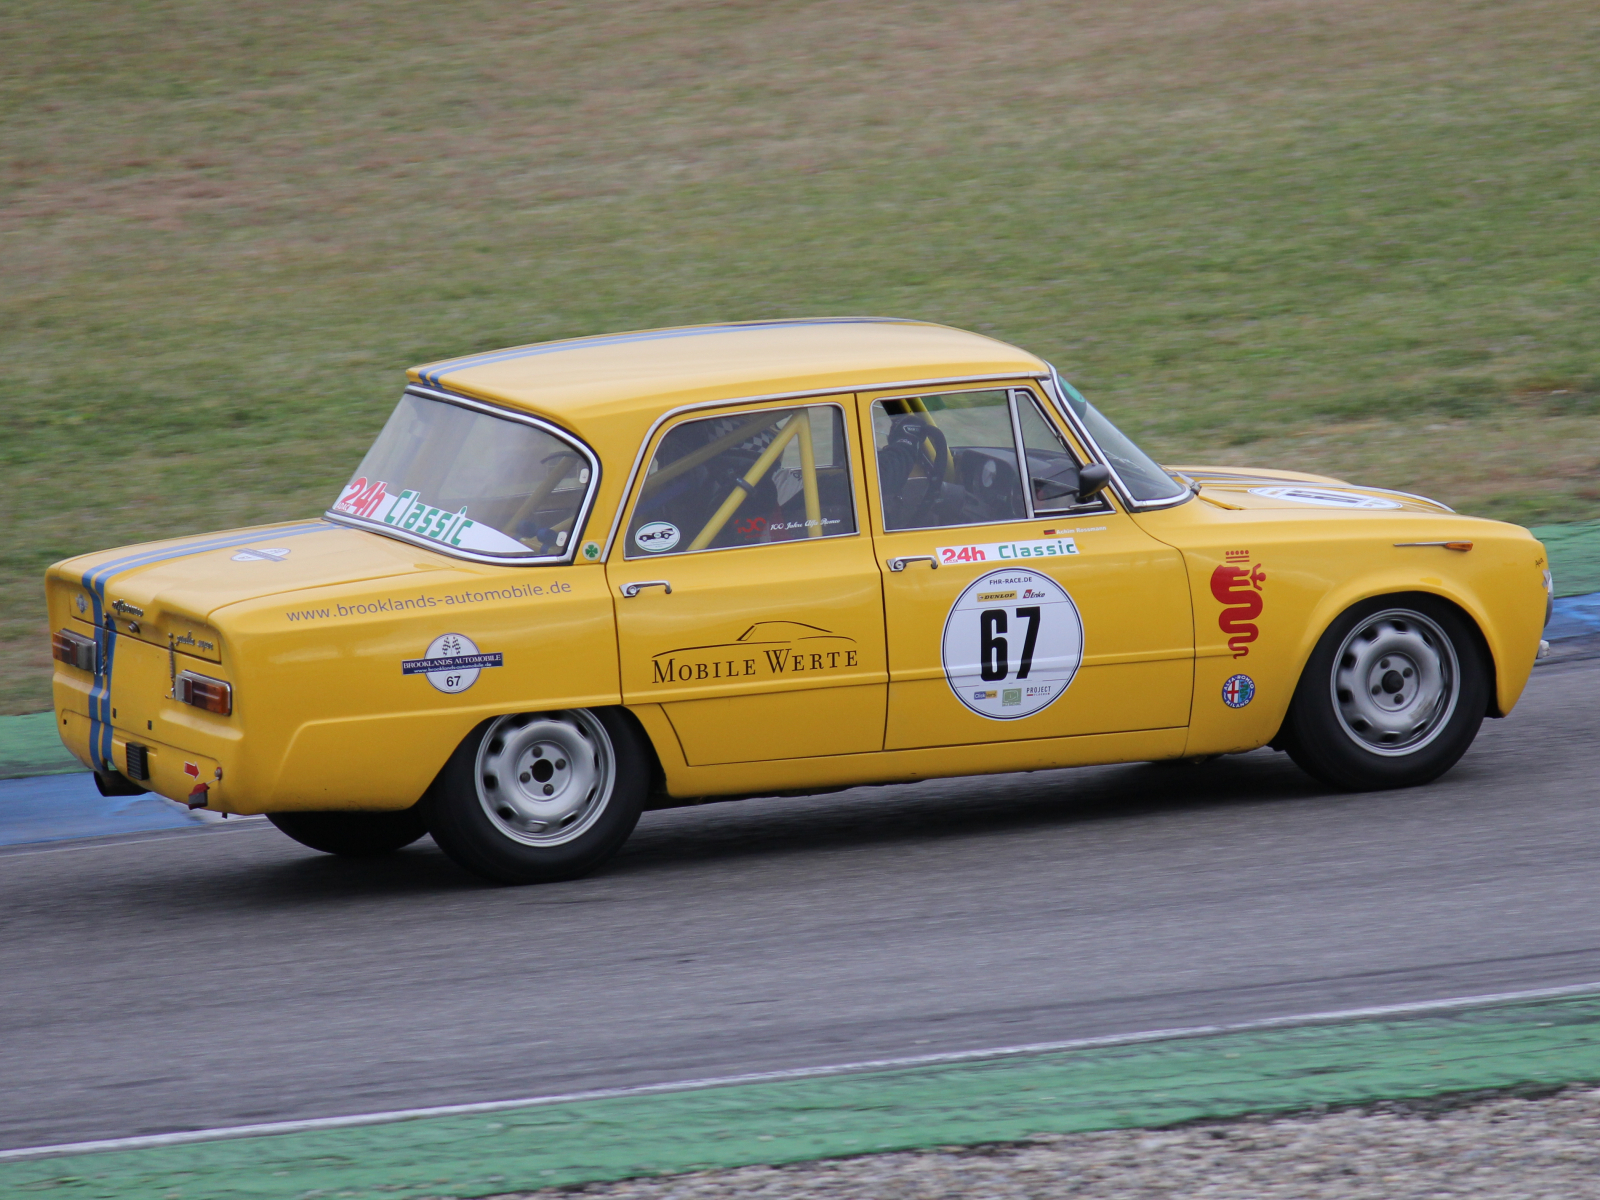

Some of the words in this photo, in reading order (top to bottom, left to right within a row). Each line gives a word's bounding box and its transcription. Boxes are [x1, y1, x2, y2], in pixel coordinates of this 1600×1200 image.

[341, 477, 386, 518] 24h
[384, 490, 473, 546] Classic
[942, 546, 986, 562] 24h
[998, 540, 1076, 559] Classic
[989, 576, 1033, 585] FHR-RACE.DE
[286, 580, 572, 622] www.brooklands-automobile.de
[980, 606, 1041, 682] 67
[402, 658, 453, 669] BROOKLANDS
[453, 654, 502, 664] AUTOMOBILE
[446, 675, 461, 687] 67
[1026, 685, 1052, 694] PROJECT
